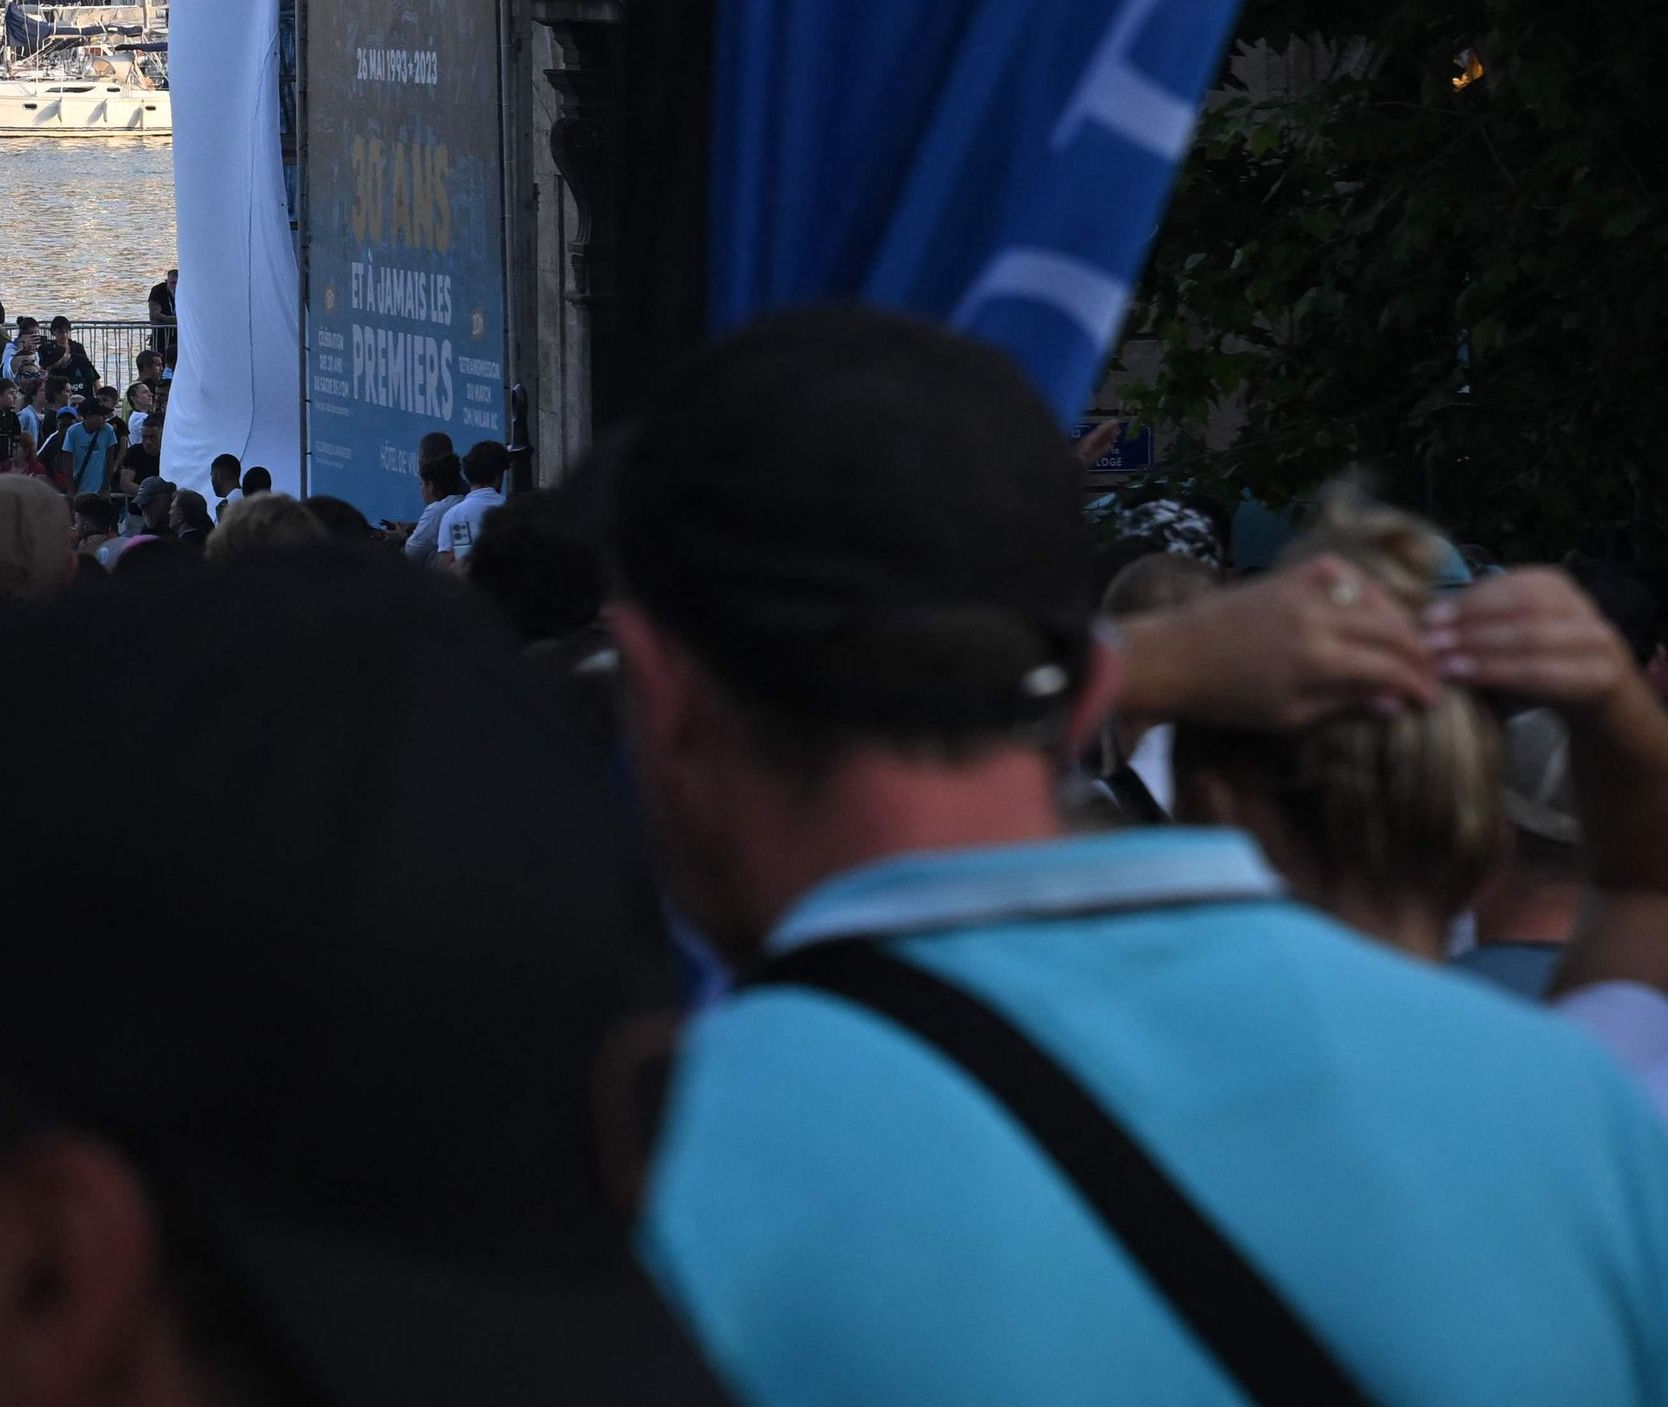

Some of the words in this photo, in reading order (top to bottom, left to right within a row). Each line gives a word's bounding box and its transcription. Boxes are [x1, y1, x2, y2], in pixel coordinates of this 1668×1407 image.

[356, 47, 368, 80] 26
[369, 48, 385, 82] MAI
[351, 136, 383, 243] 30
[390, 141, 452, 256] ANS
[351, 262, 365, 311] ET
[377, 264, 427, 322] JAMAIS
[429, 273, 452, 326] LES
[352, 323, 454, 422] PREMIERS
